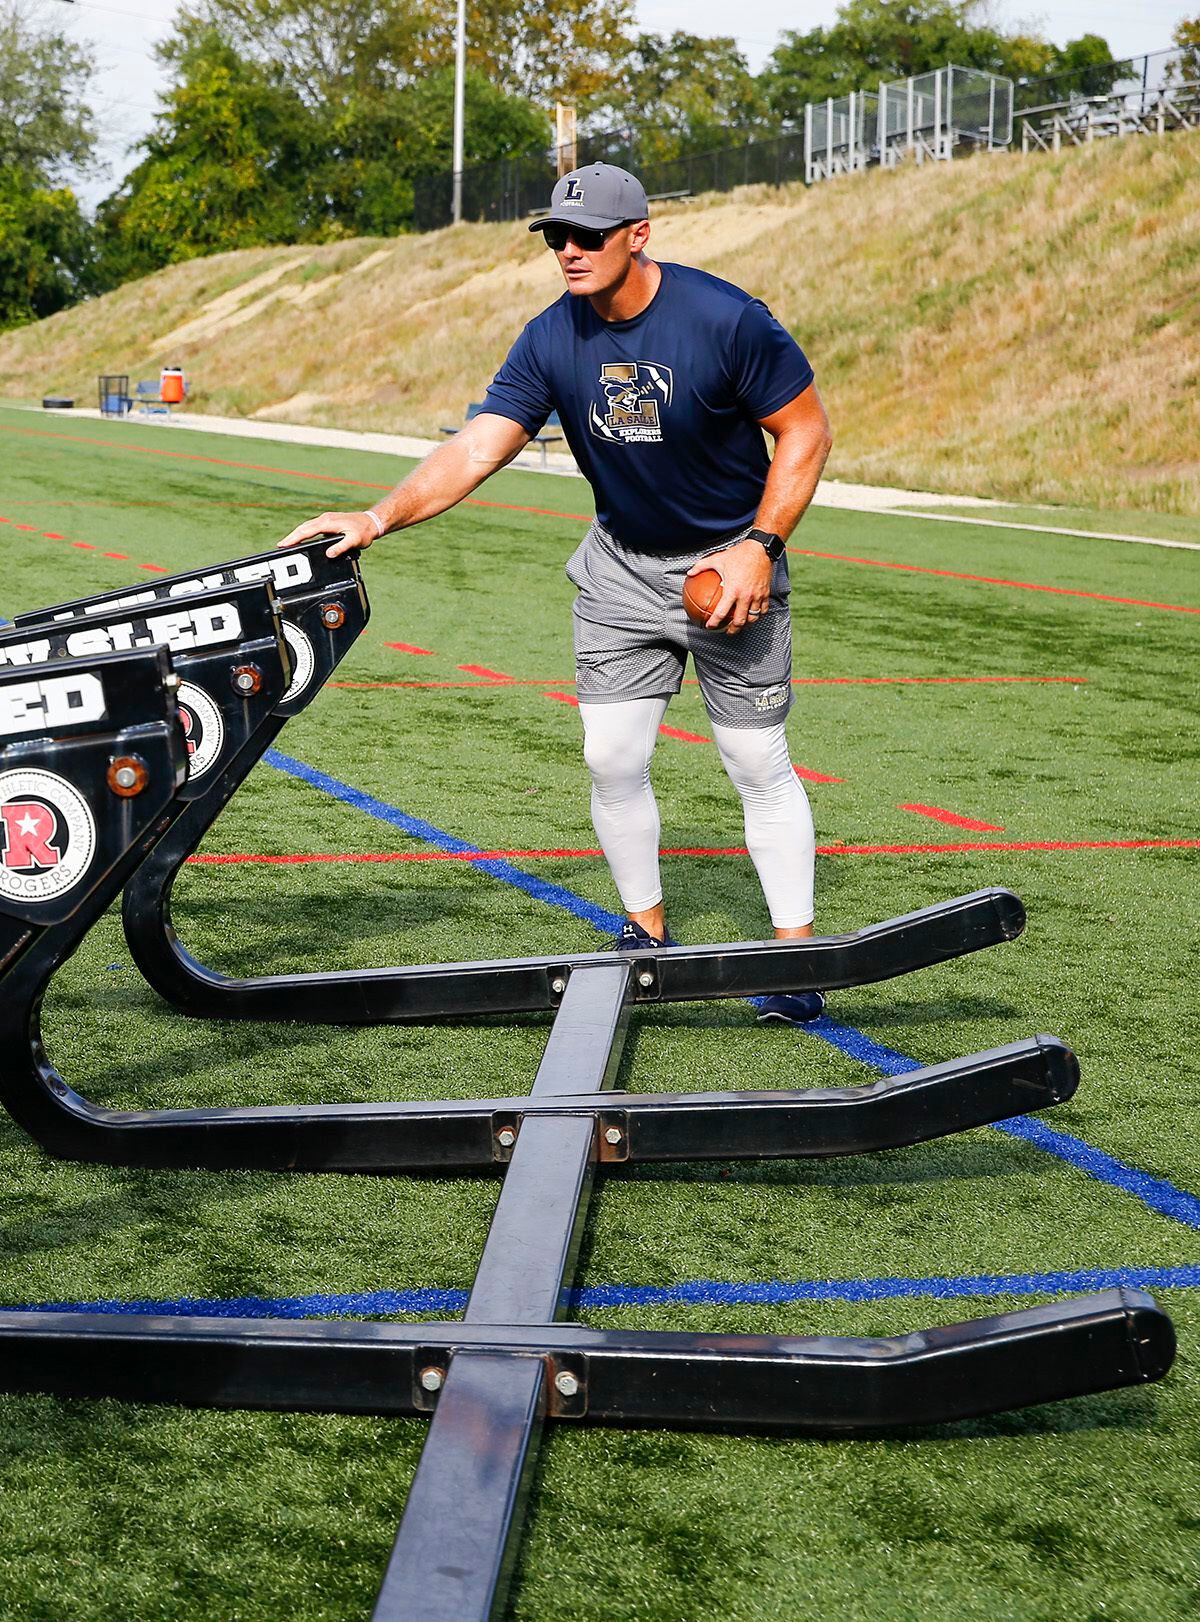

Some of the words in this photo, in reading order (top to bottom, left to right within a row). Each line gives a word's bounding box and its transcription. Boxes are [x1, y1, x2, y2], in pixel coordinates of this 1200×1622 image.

[563, 177, 585, 201] L
[610, 417, 626, 426] LA
[625, 435, 663, 443] FOOTBALL
[49, 787, 85, 853] COMPANY
[0, 802, 60, 868] R
